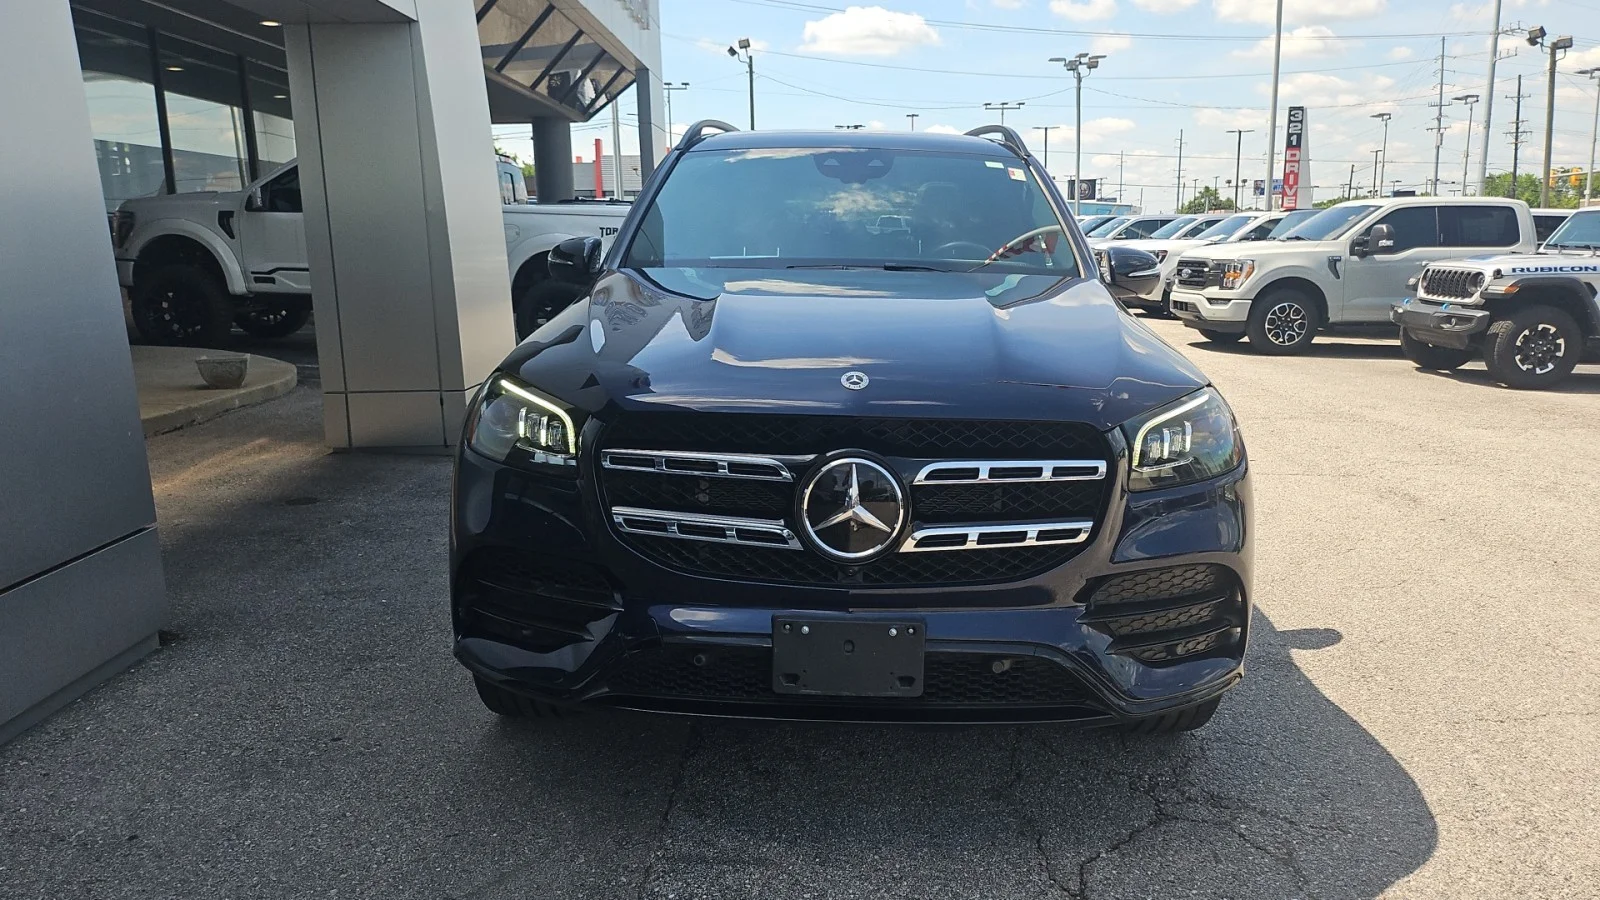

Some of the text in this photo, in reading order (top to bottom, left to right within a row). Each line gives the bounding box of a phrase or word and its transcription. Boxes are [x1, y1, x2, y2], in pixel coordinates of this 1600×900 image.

[1283, 109, 1303, 208] 321 DRIVE
[1511, 265, 1598, 273] RUBICON
